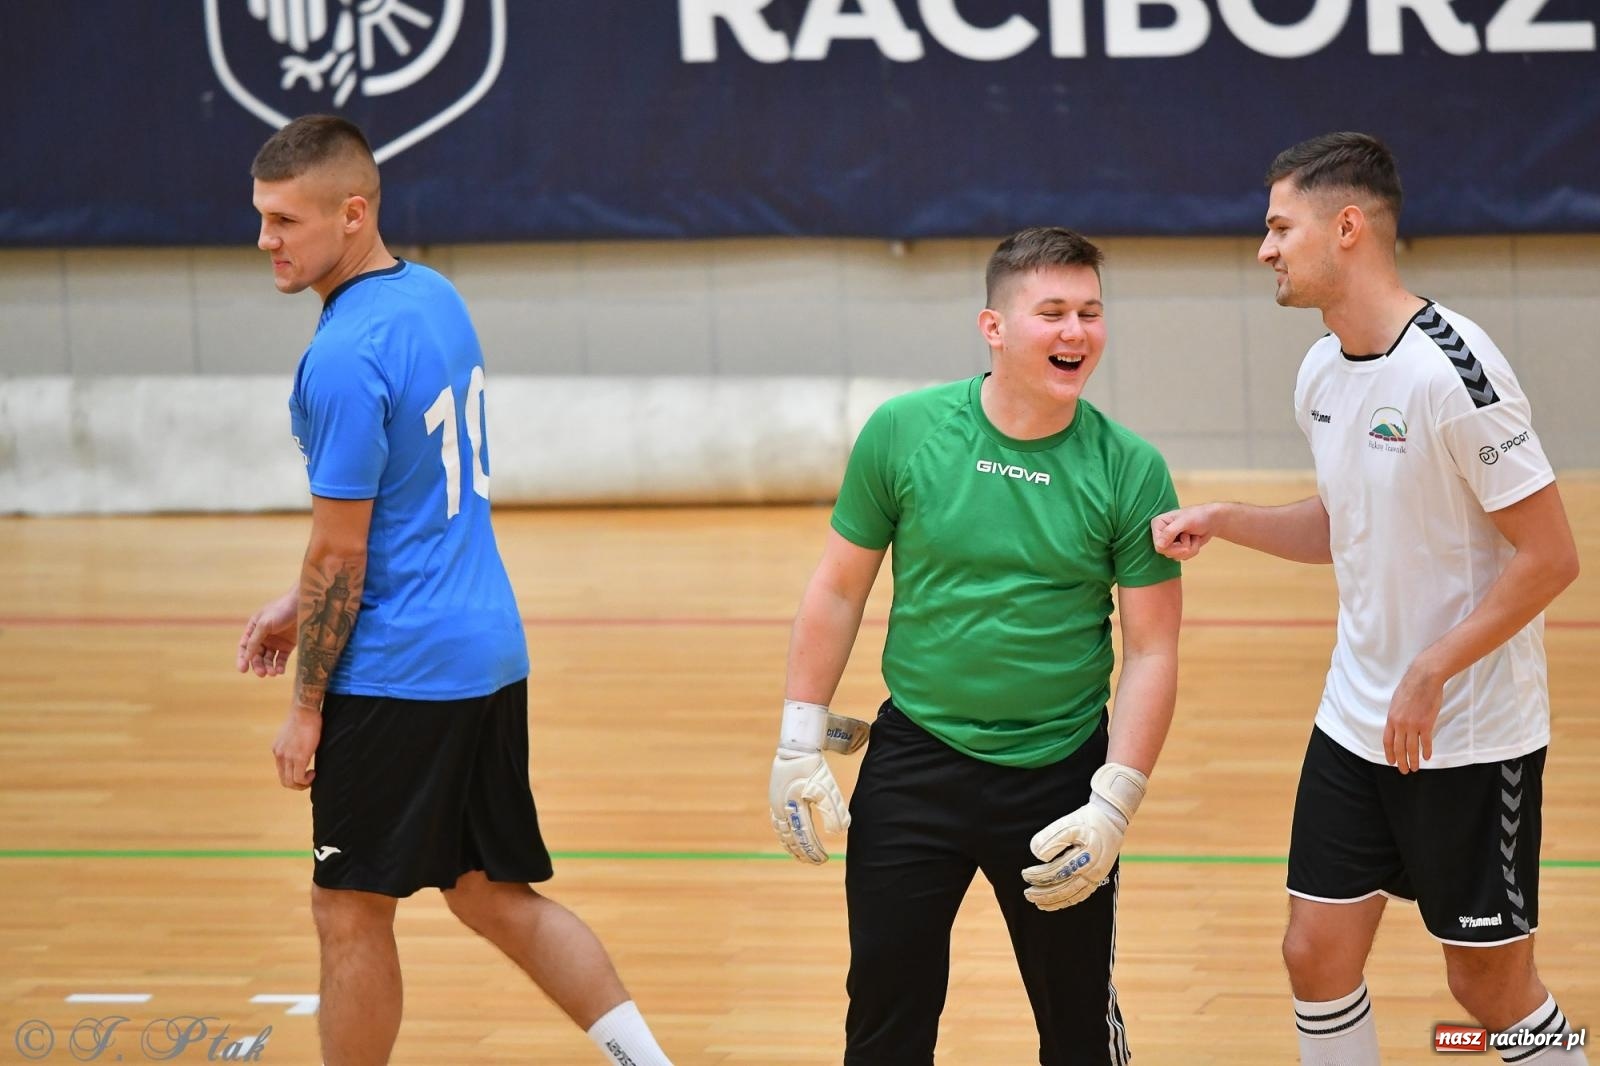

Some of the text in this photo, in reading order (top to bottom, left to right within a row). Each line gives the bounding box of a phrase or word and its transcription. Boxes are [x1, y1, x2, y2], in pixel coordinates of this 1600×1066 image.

[423, 365, 490, 520] 10
[1500, 431, 1530, 453] SPORT
[976, 459, 1051, 486] GIVOVA
[1468, 912, 1502, 928] hummel
